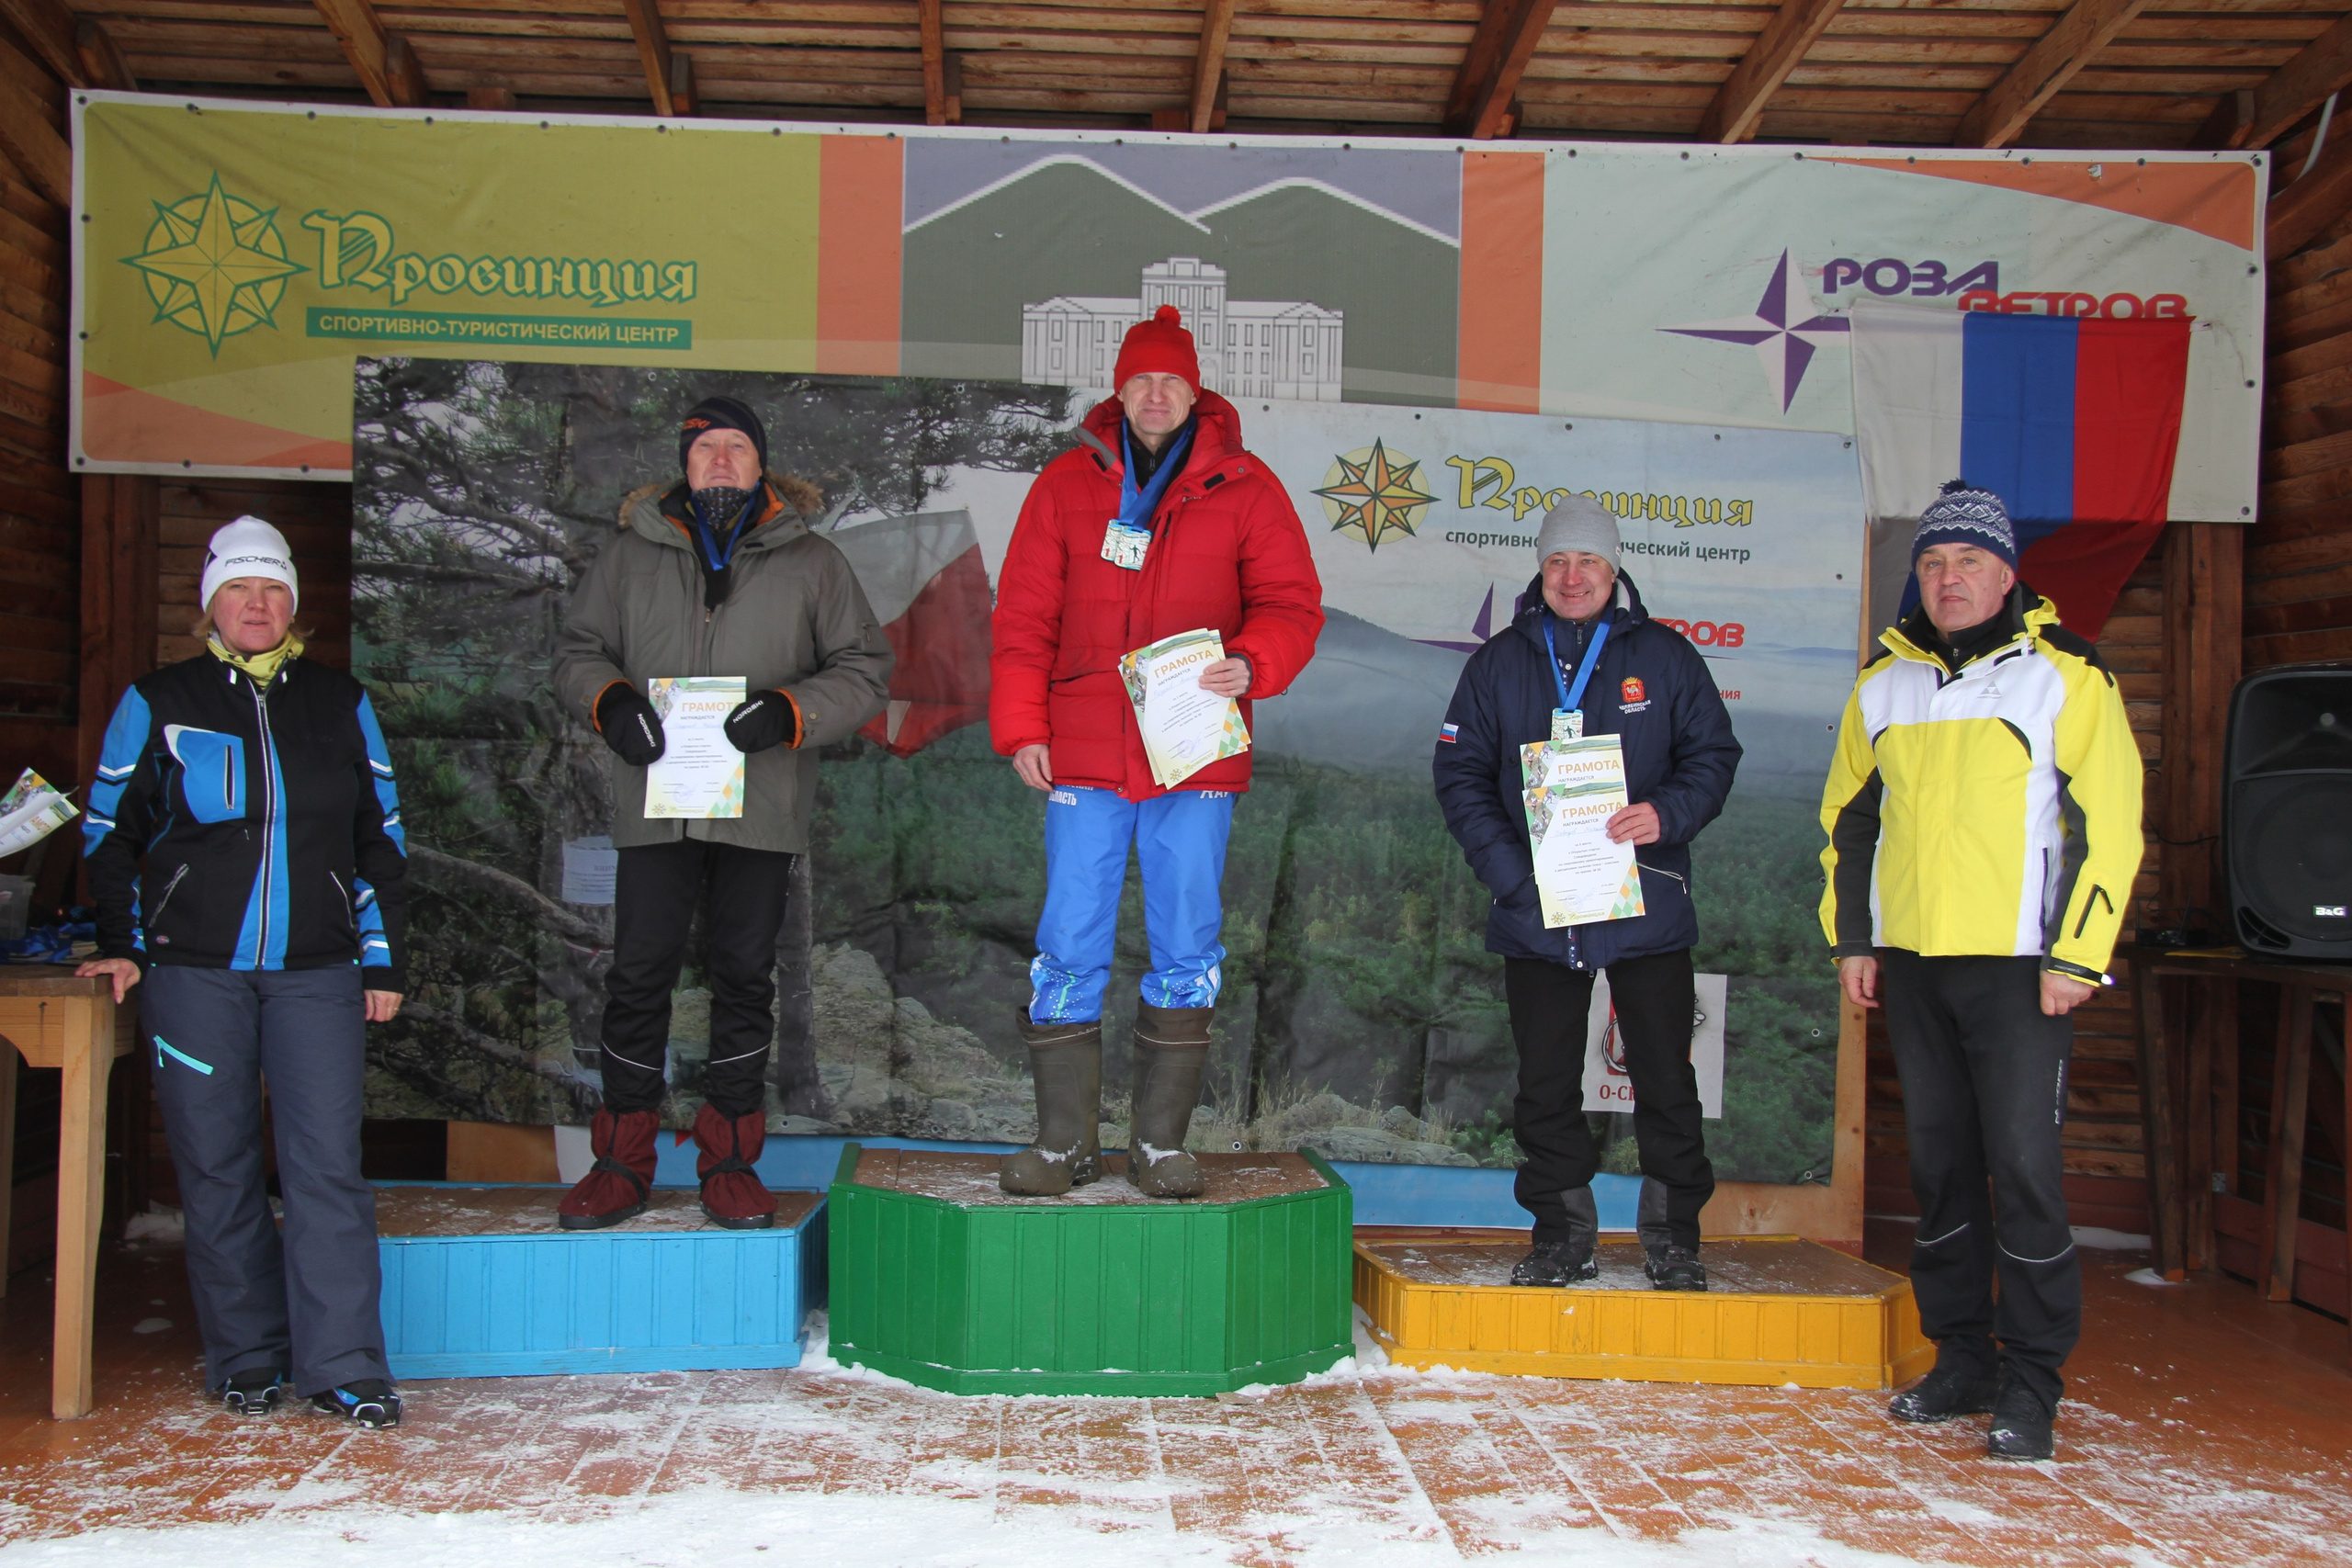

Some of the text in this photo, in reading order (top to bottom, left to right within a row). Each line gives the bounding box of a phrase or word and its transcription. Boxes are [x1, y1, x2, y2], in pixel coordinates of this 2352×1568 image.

[1822, 258, 1999, 296] РОЗА
[319, 314, 680, 344] СПОРТИВНО-ТУРИСТИЧЕСКИЙ ЦЕНТР
[224, 555, 281, 568] FISCHER
[1695, 547, 1751, 565] центр
[1154, 649, 1214, 679] ГРАМОТА
[1557, 759, 1621, 775] ГРАМОТА
[2315, 907, 2346, 916] B&G
